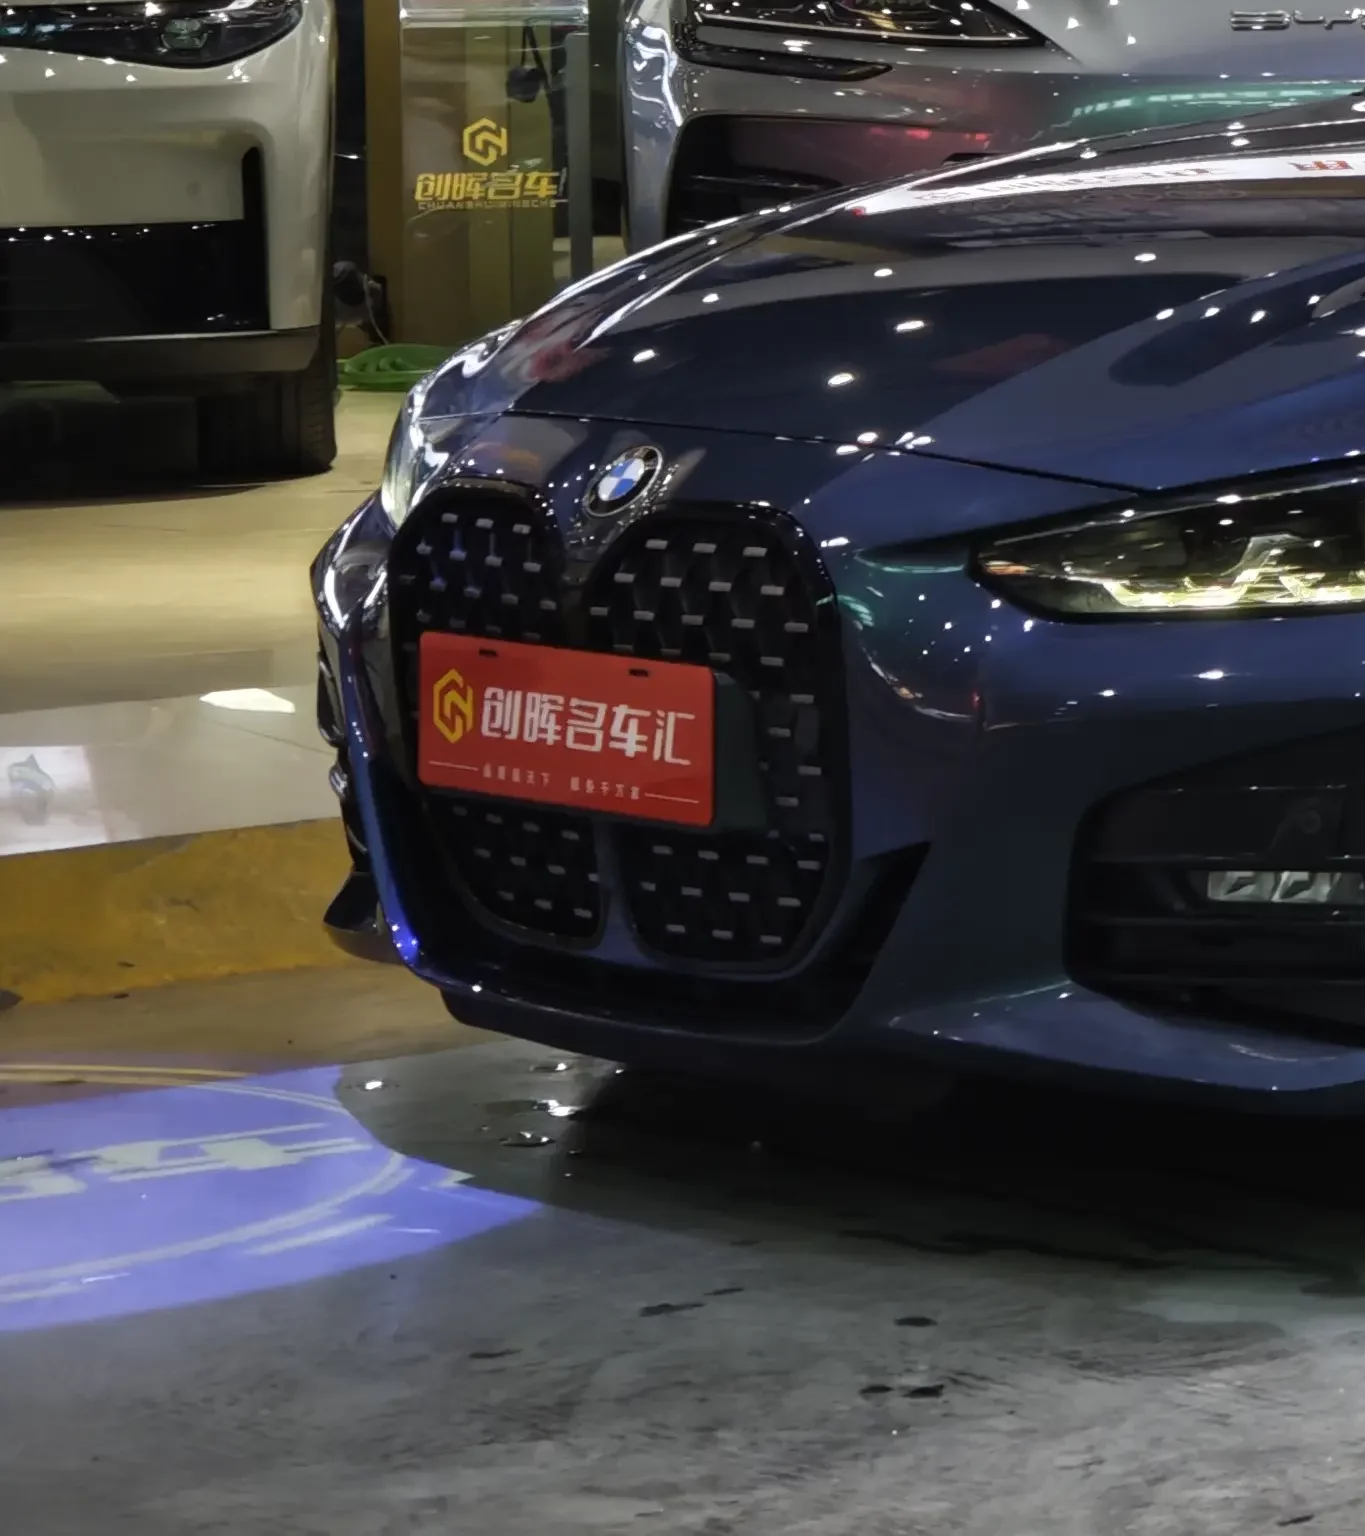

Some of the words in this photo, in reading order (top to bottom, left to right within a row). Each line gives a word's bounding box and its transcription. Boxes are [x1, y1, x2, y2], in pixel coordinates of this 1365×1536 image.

[414, 171, 561, 202] 创晖名车
[481, 686, 696, 766] 创晖名车汇
